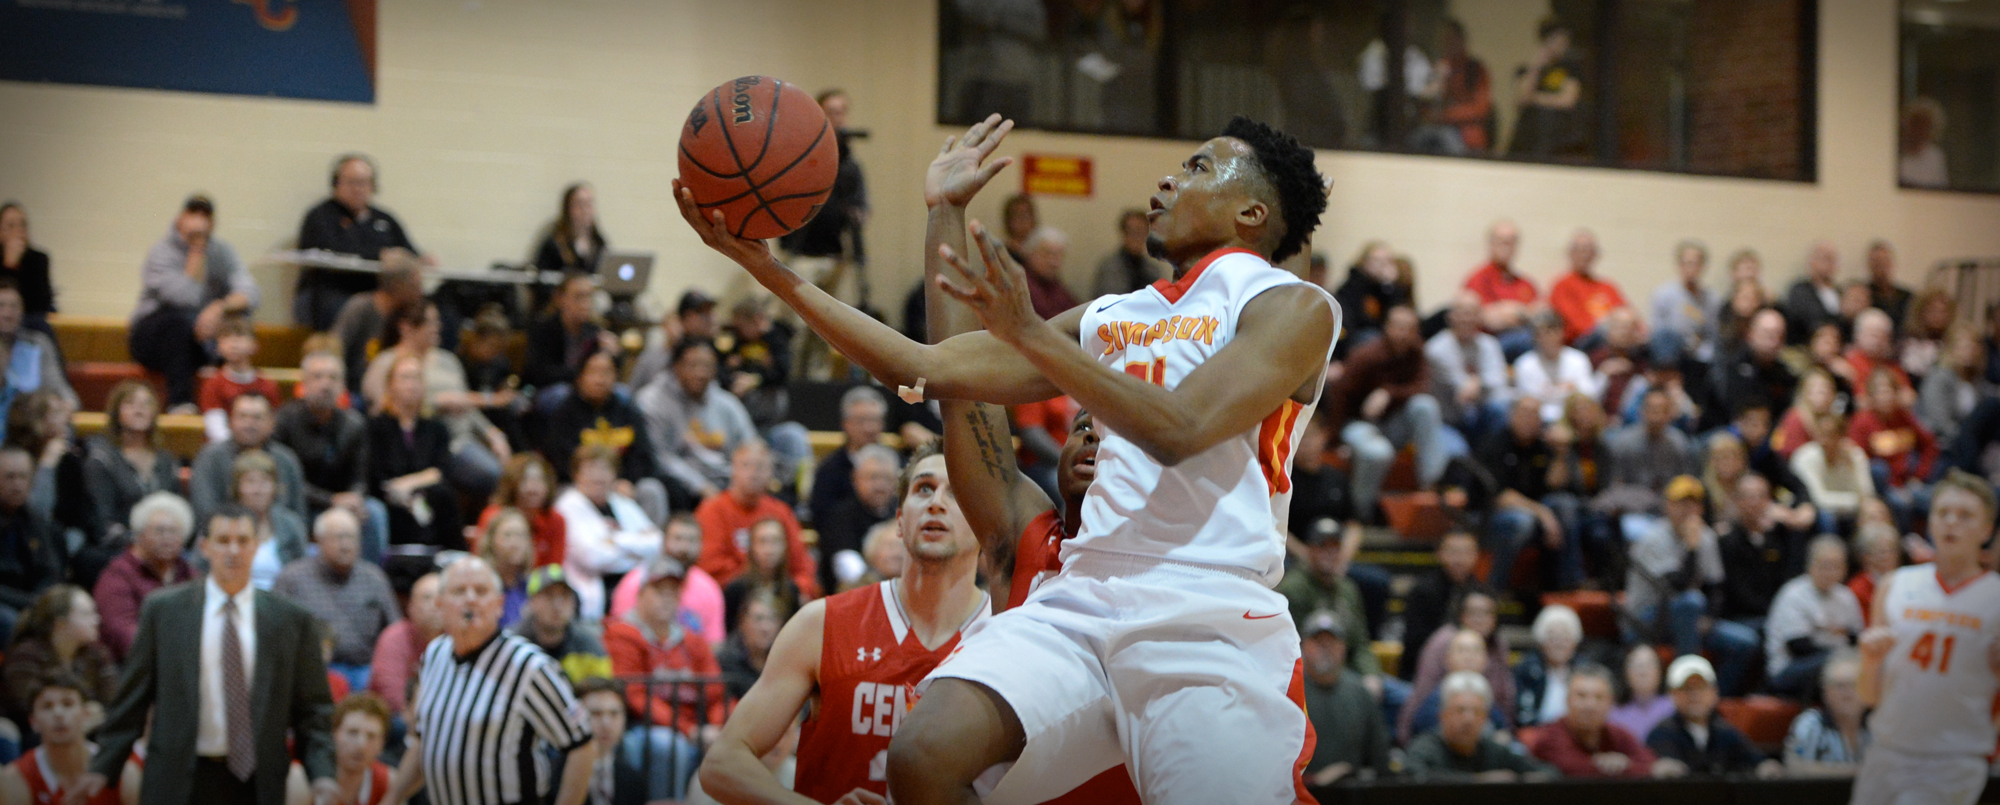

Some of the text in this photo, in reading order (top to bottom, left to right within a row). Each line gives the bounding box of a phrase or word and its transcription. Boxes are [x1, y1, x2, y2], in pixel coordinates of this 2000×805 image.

[733, 76, 762, 126] ilson
[1097, 315, 1220, 356] SIMPSON
[1910, 632, 1956, 673] 41
